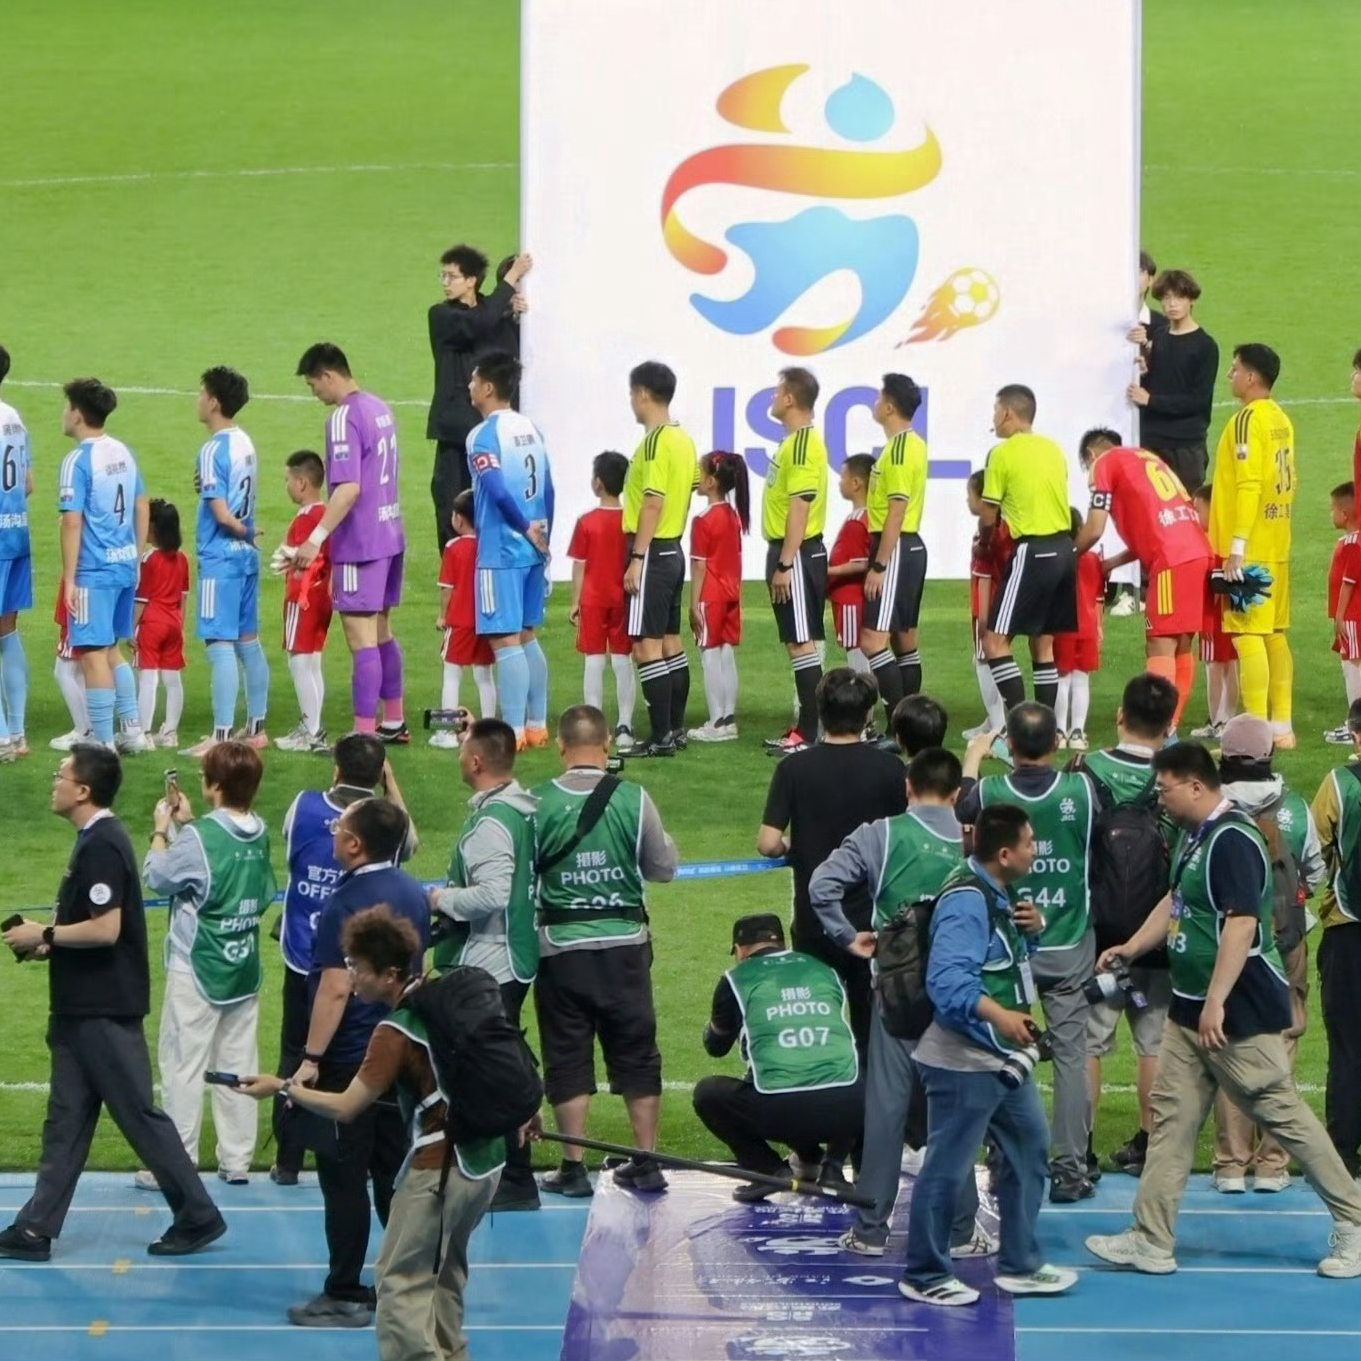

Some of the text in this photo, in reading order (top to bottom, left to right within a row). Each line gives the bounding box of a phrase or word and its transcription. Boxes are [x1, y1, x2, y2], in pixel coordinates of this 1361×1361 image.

[523, 453, 537, 502] 3
[113, 482, 127, 527] 4
[576, 849, 607, 869] 摄影
[560, 866, 625, 885] PHOTO
[780, 985, 812, 1002] 摄影
[765, 1001, 831, 1022] PHOTO
[778, 1026, 830, 1049] G07
